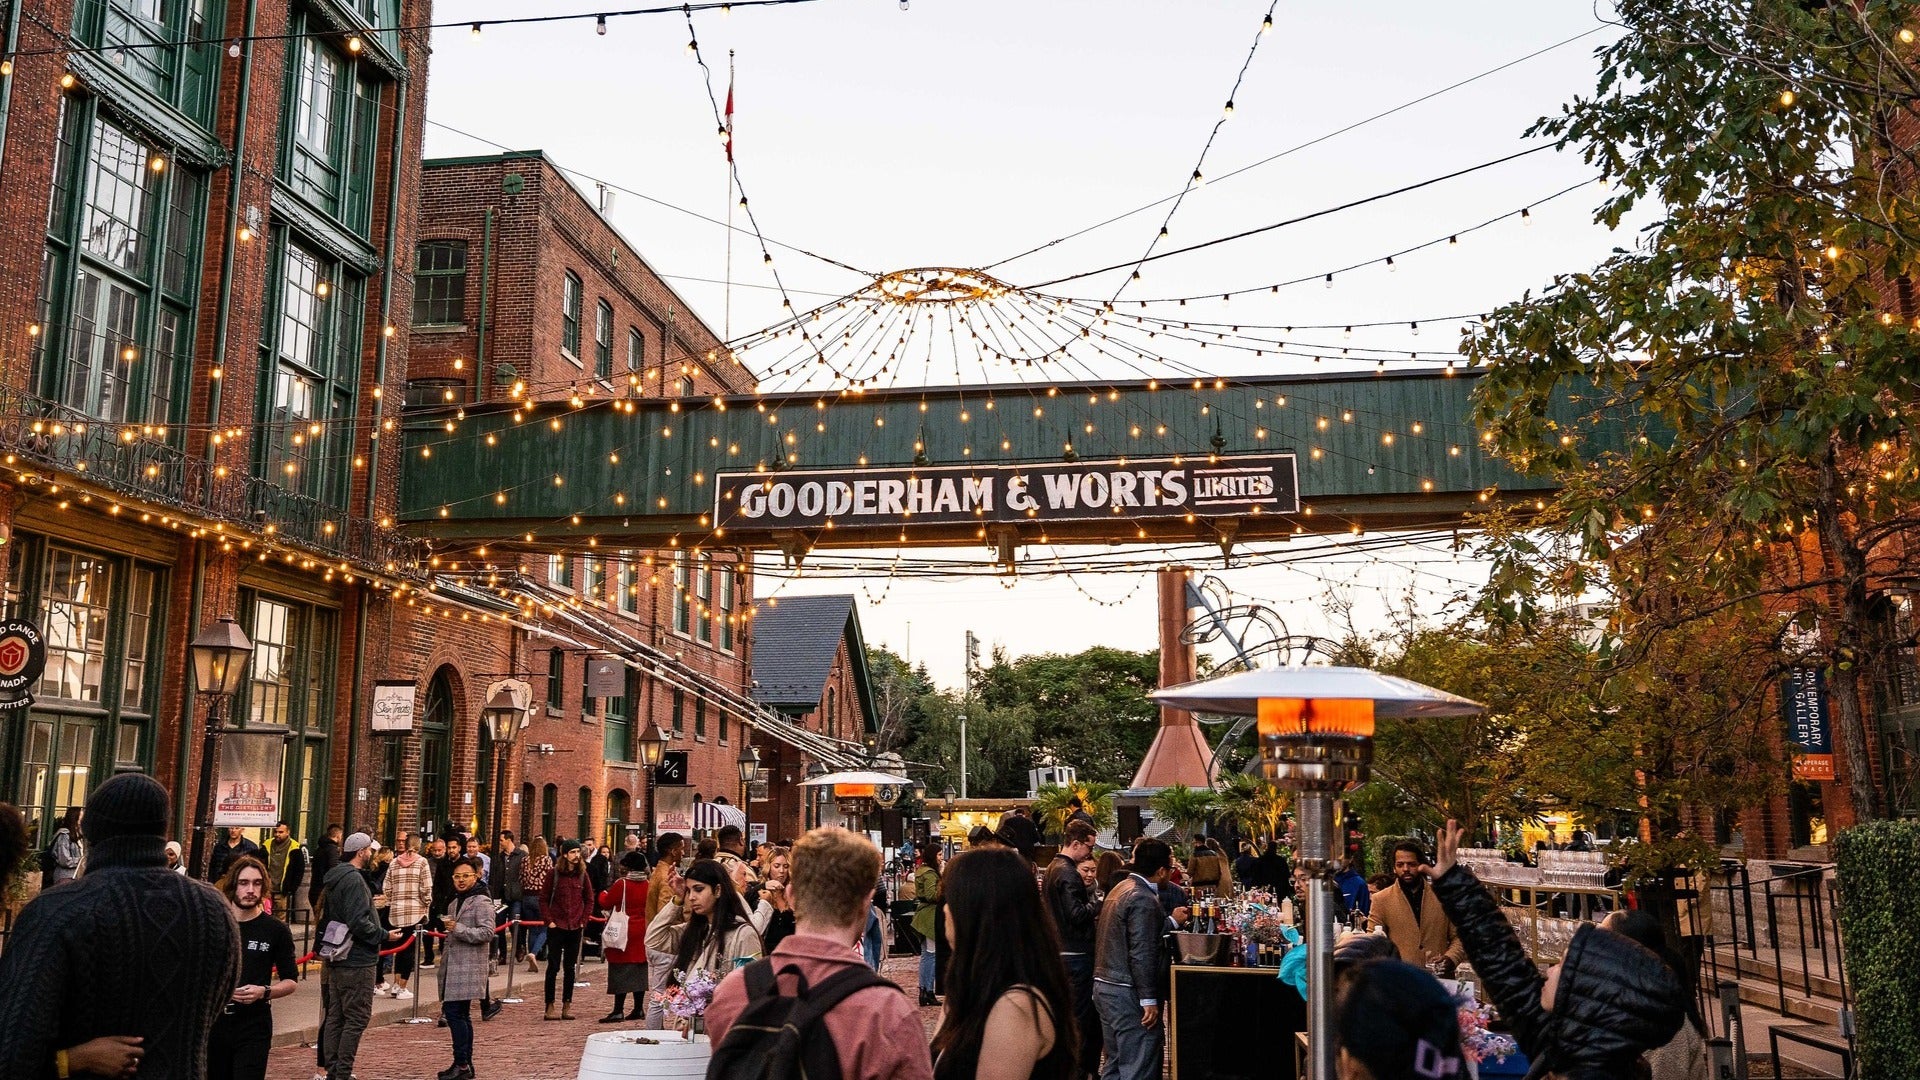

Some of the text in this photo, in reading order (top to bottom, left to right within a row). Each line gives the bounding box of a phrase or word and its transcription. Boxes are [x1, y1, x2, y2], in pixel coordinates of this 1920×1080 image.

[739, 470, 1273, 519] GOODERHAM & WORTS LIMITED
[9, 623, 39, 645] CANOE
[0, 675, 27, 687] NADA
[0, 697, 29, 709] FITTER
[1795, 692, 1809, 746] GALLERY
[1806, 668, 1822, 746] ONTEMPORARY
